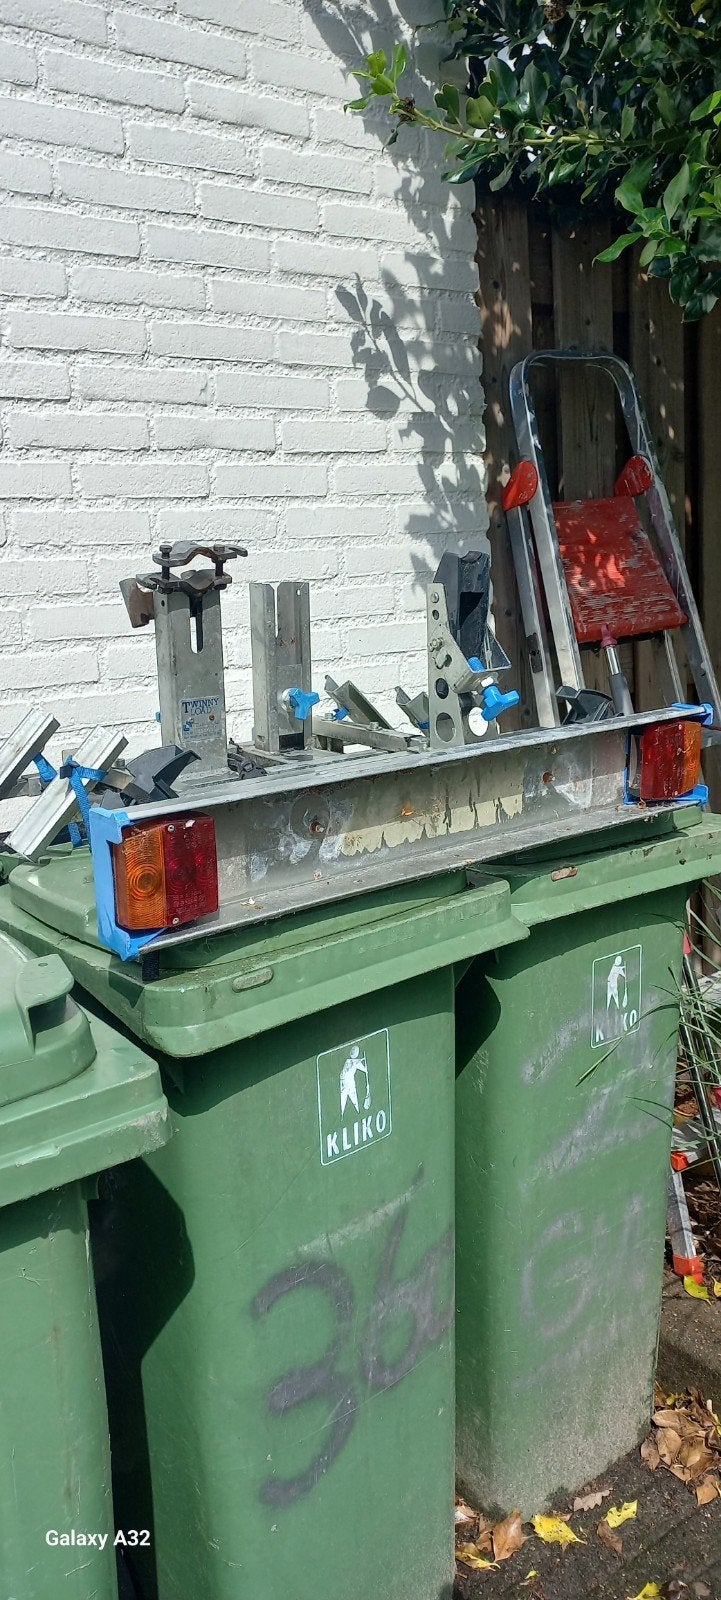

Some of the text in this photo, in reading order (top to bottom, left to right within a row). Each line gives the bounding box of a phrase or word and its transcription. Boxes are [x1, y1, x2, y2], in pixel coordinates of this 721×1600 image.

[182, 698, 219, 713] TWINNY
[191, 706, 212, 716] LOAD
[595, 1009, 638, 1043] KKO
[326, 1109, 387, 1158] KLIKO
